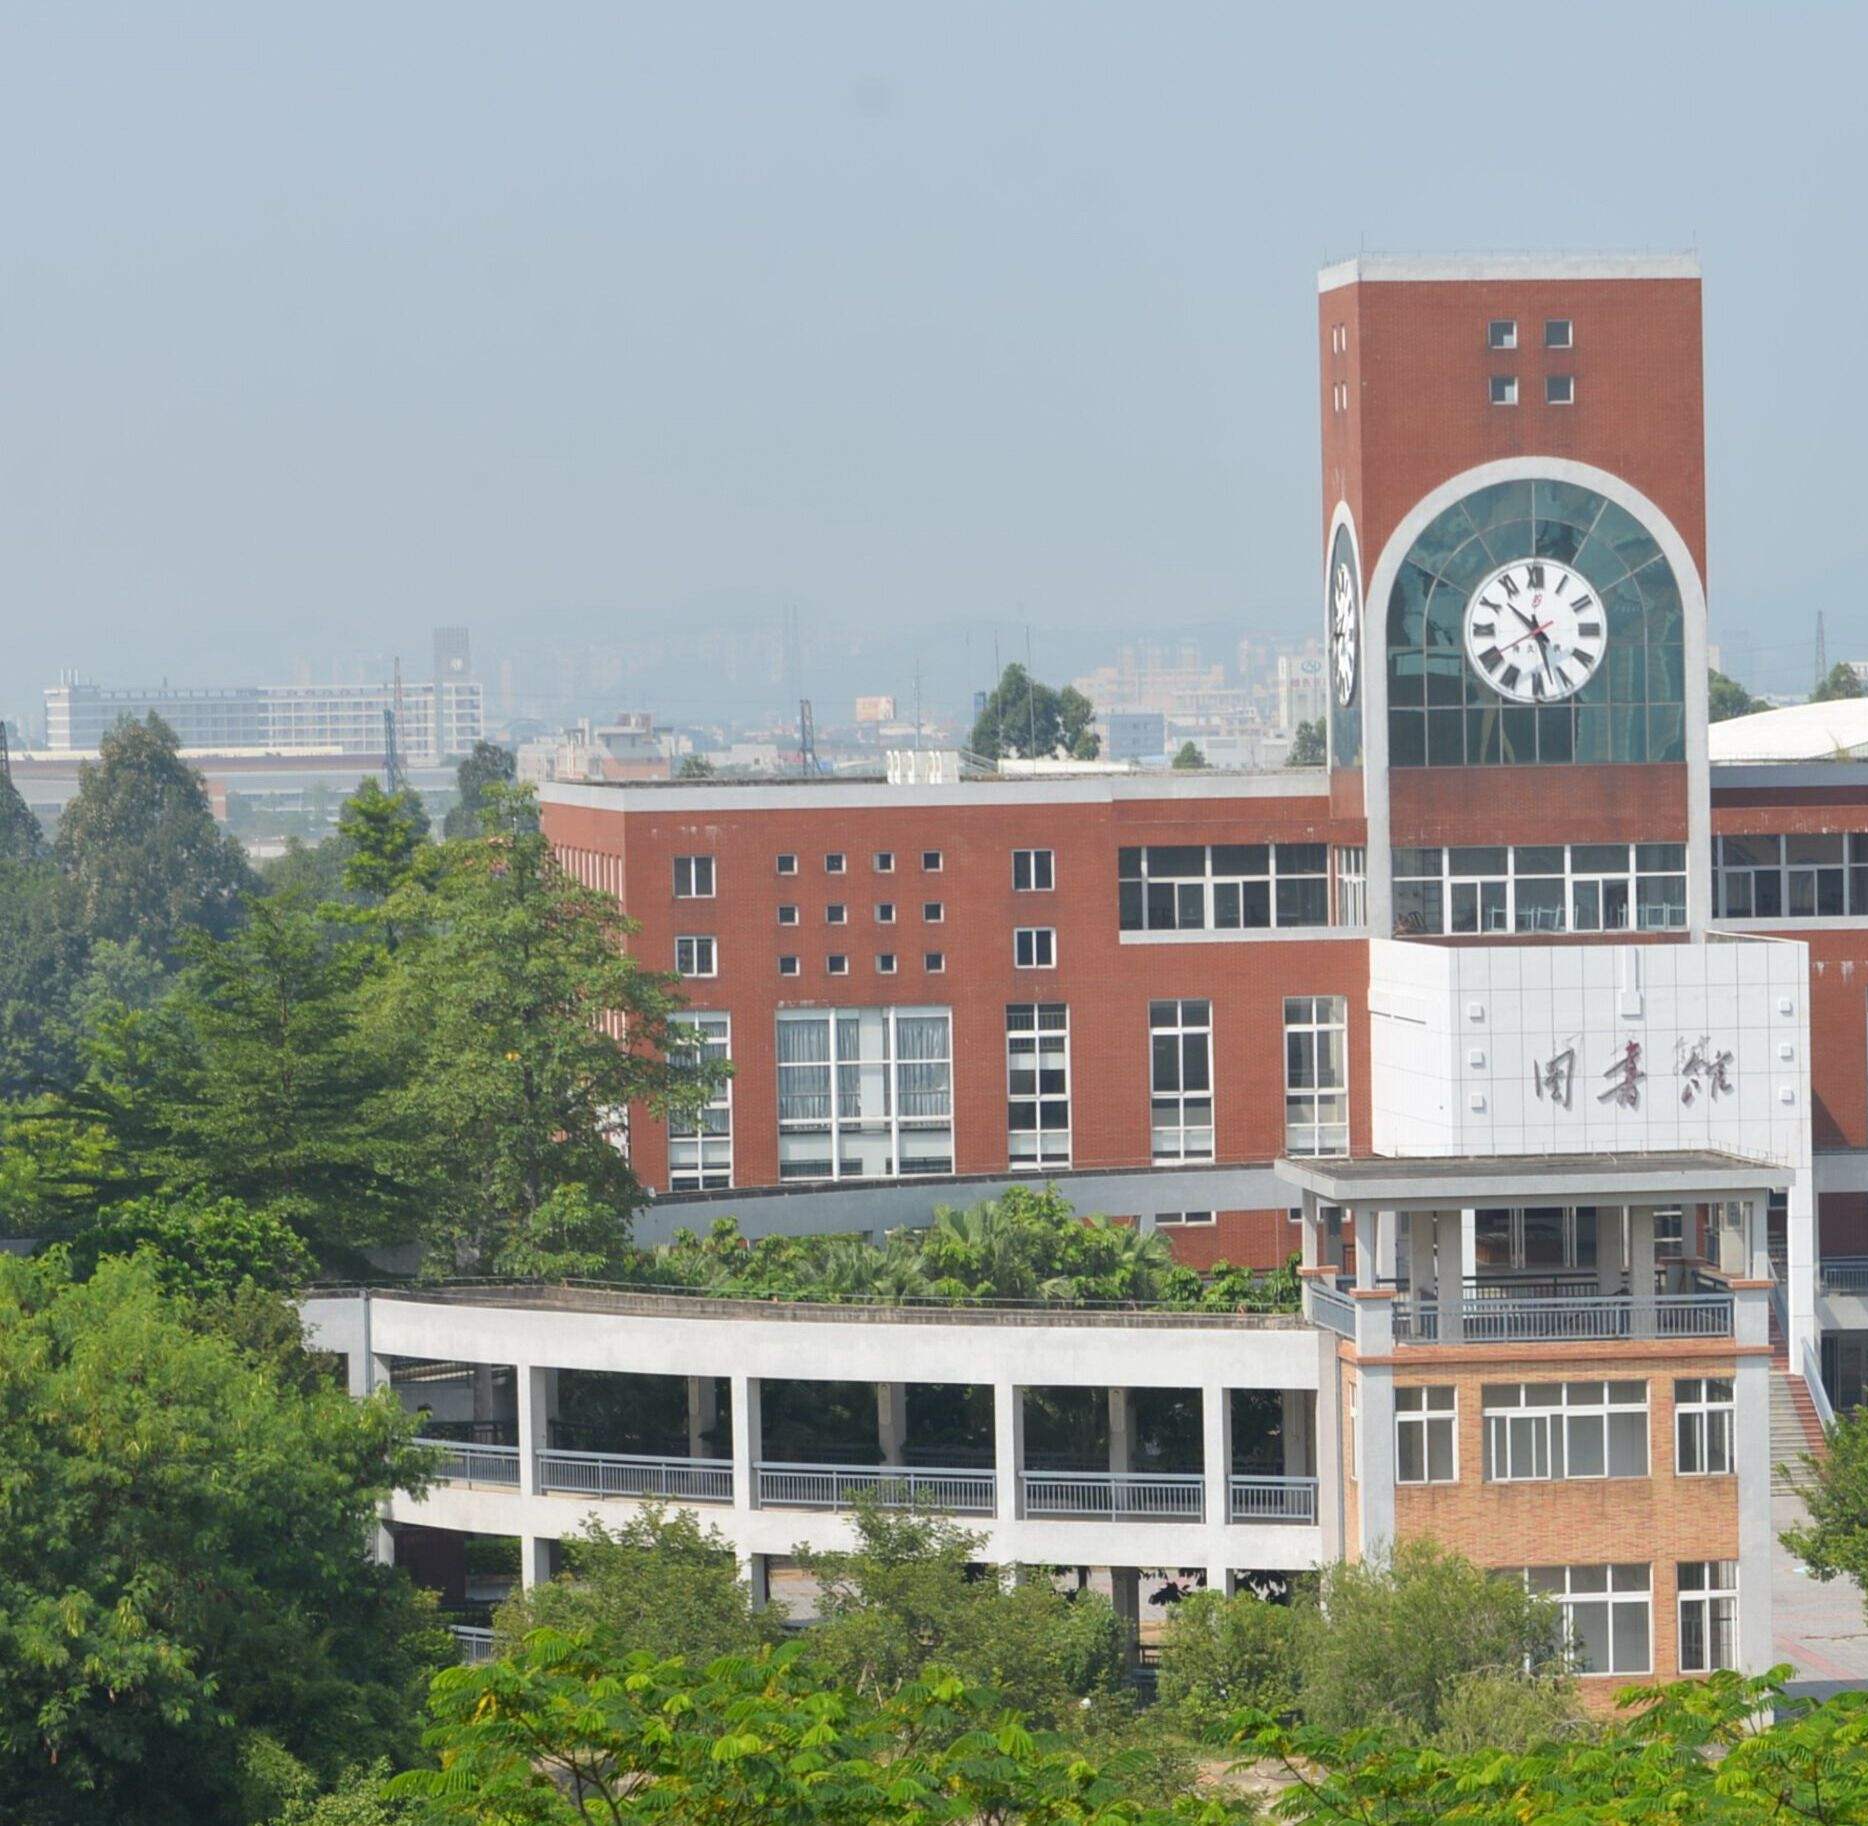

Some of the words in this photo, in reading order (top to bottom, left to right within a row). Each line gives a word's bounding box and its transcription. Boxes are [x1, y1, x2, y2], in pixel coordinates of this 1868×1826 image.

[1498, 574, 1520, 598] XI
[1526, 566, 1545, 589] XII
[1479, 596, 1502, 613] X
[1570, 594, 1593, 613] II
[1473, 622, 1495, 637] IX
[1578, 622, 1600, 637] III
[1532, 673, 1546, 696] VI
[1556, 667, 1574, 688] V
